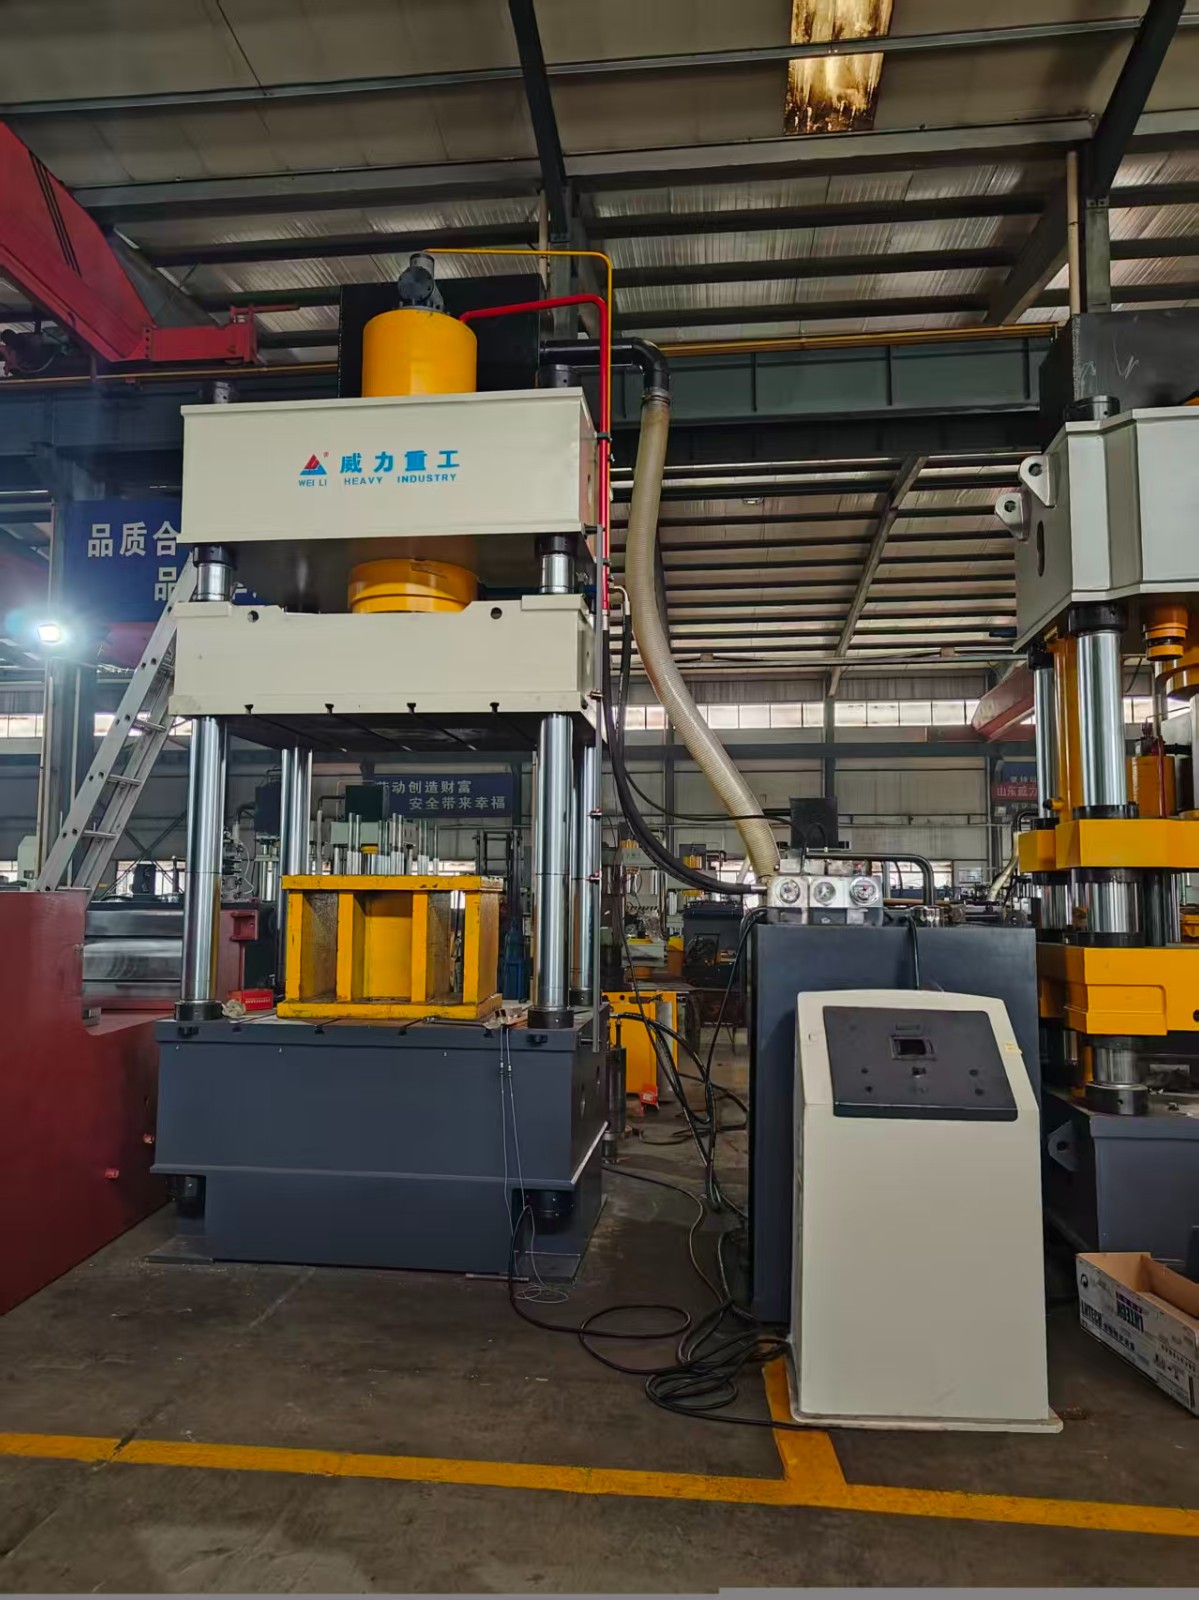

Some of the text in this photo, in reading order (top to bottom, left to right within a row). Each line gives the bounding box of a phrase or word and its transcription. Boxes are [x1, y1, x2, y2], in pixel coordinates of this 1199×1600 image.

[340, 450, 460, 474] 威力重工
[298, 473, 457, 487] WEI LI HEAVY INDUSTRY
[88, 521, 180, 557] 品质合
[409, 795, 506, 810] 安全带来幸福
